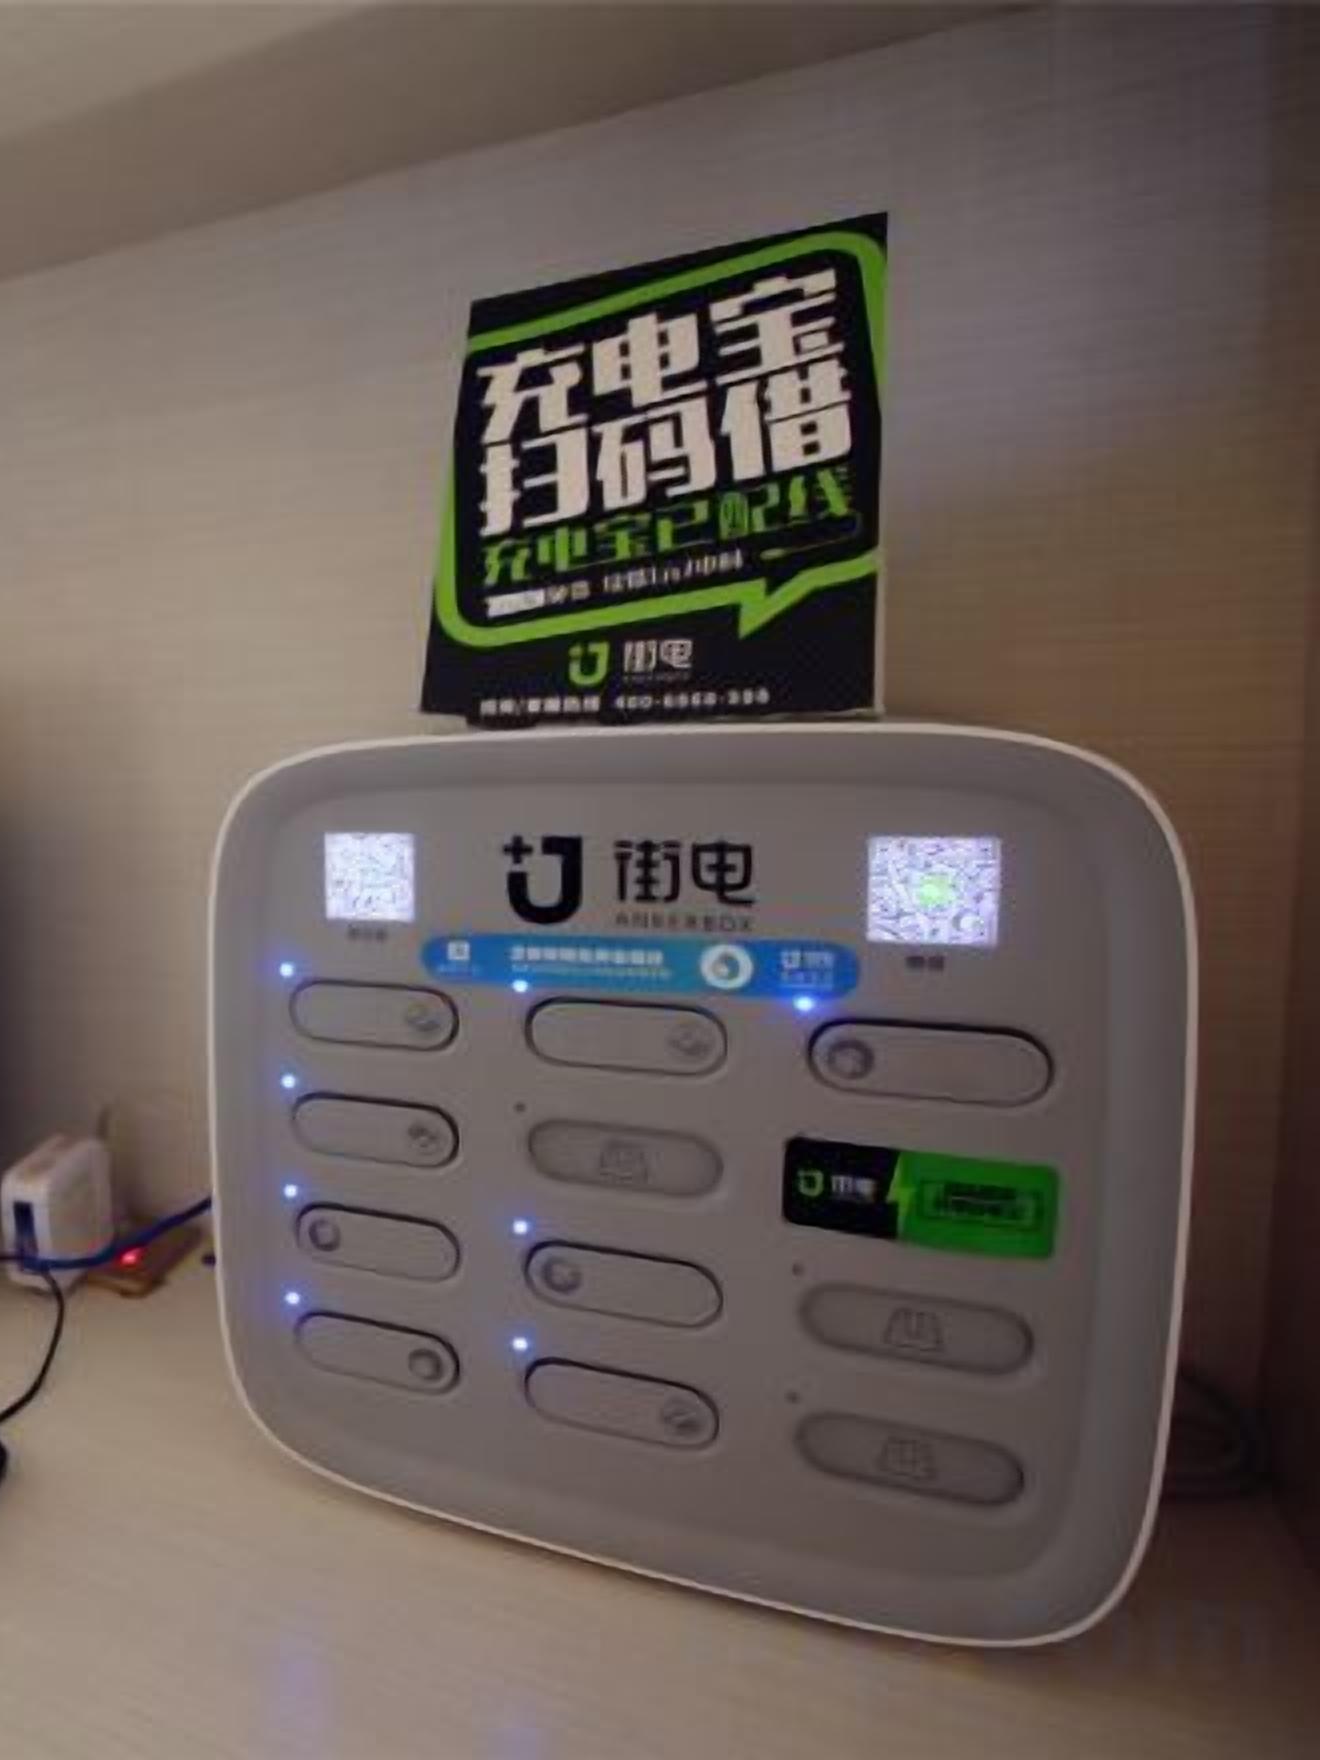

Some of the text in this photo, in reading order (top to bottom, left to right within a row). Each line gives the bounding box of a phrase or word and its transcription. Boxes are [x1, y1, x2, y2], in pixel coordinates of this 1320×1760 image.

[477, 269, 844, 446] 充电宝
[479, 359, 853, 537] 扫码借
[612, 837, 759, 907] 街电
